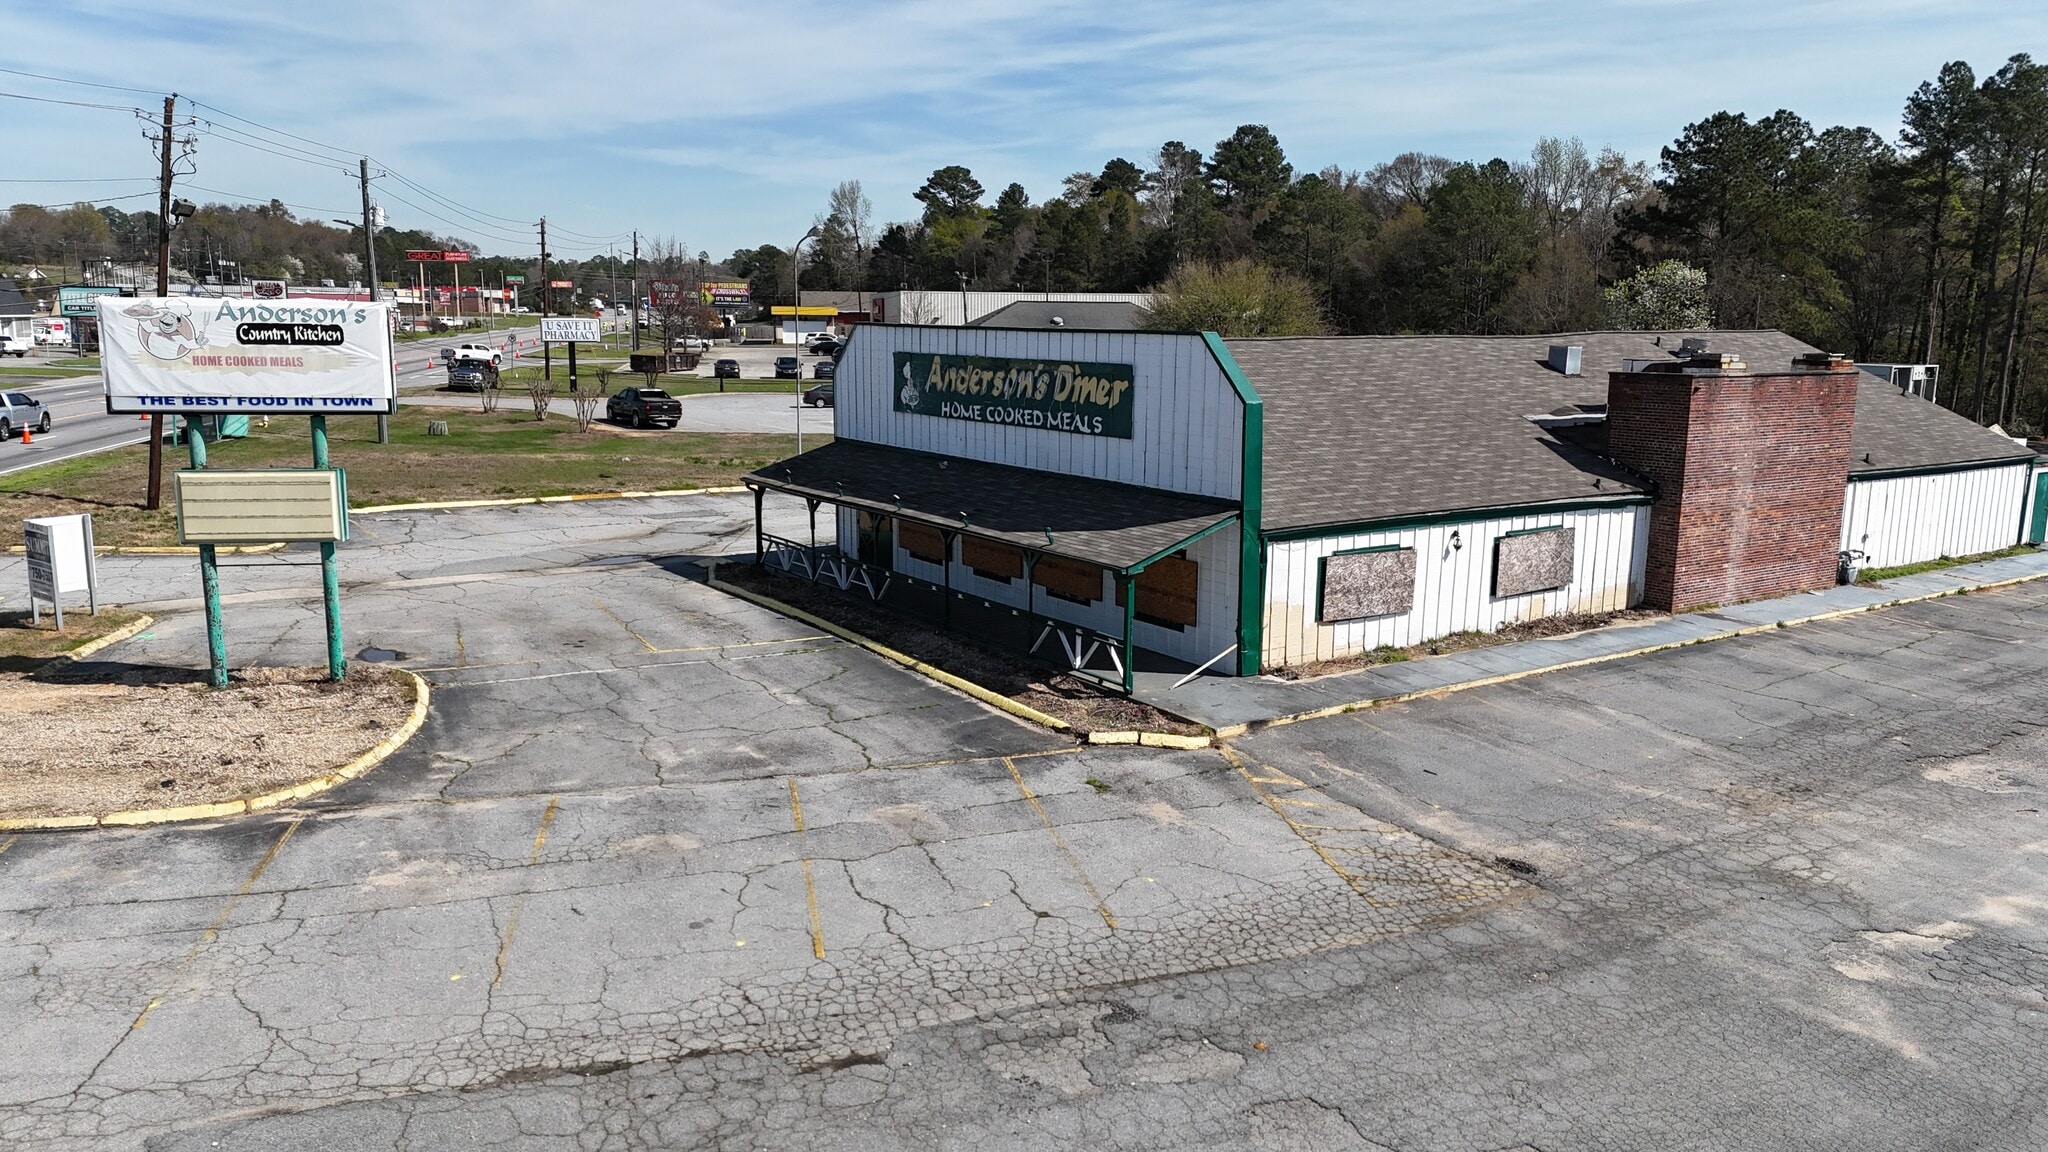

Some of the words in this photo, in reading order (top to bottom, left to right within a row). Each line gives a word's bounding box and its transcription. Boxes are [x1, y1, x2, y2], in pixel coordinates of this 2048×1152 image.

[407, 252, 443, 260] GREAT
[214, 300, 367, 324] Anderson's
[545, 321, 554, 331] U
[556, 321, 581, 331] SAVE
[583, 321, 594, 331] IT
[239, 325, 291, 344] Country
[294, 325, 342, 341] Kitchen
[544, 330, 597, 340] PHARMACY
[192, 355, 223, 367] HOME
[225, 355, 267, 367] COOKED
[269, 356, 304, 368] MEALS
[924, 355, 1050, 401] Anderson's
[137, 396, 176, 406] THE
[182, 396, 230, 406] BEST
[237, 397, 288, 406] FOOD
[294, 397, 314, 406] IN
[319, 397, 373, 407] TOWN
[940, 401, 982, 420] HOME
[986, 406, 1043, 426] COOKED
[1046, 411, 1103, 434] MEALS
[25, 535, 50, 557] SUMMIT
